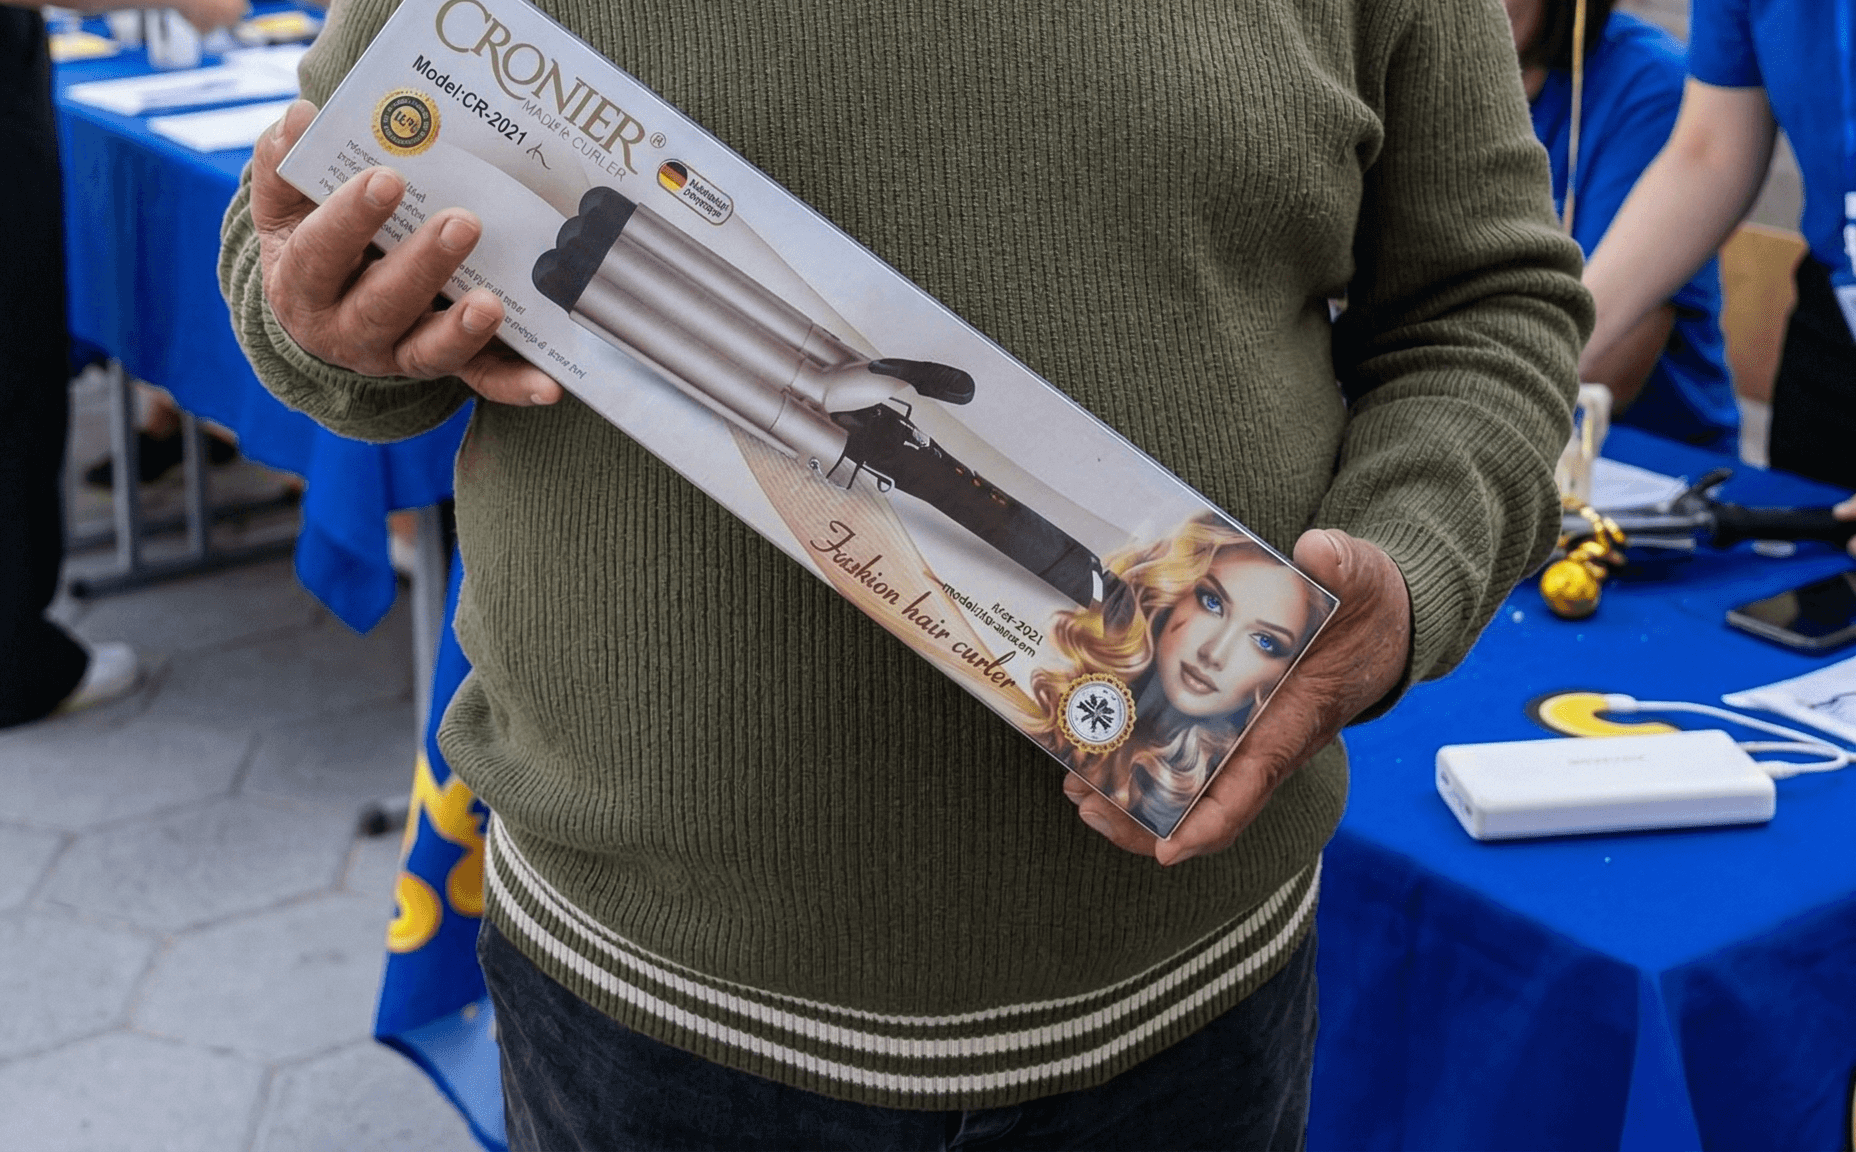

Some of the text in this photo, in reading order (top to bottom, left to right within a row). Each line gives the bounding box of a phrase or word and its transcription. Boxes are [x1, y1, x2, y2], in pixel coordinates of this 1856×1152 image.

[412, 54, 528, 146] Model:CR-2021
[572, 136, 626, 183] CURLER
[901, 590, 950, 640] hair
[951, 640, 1017, 689] curler
